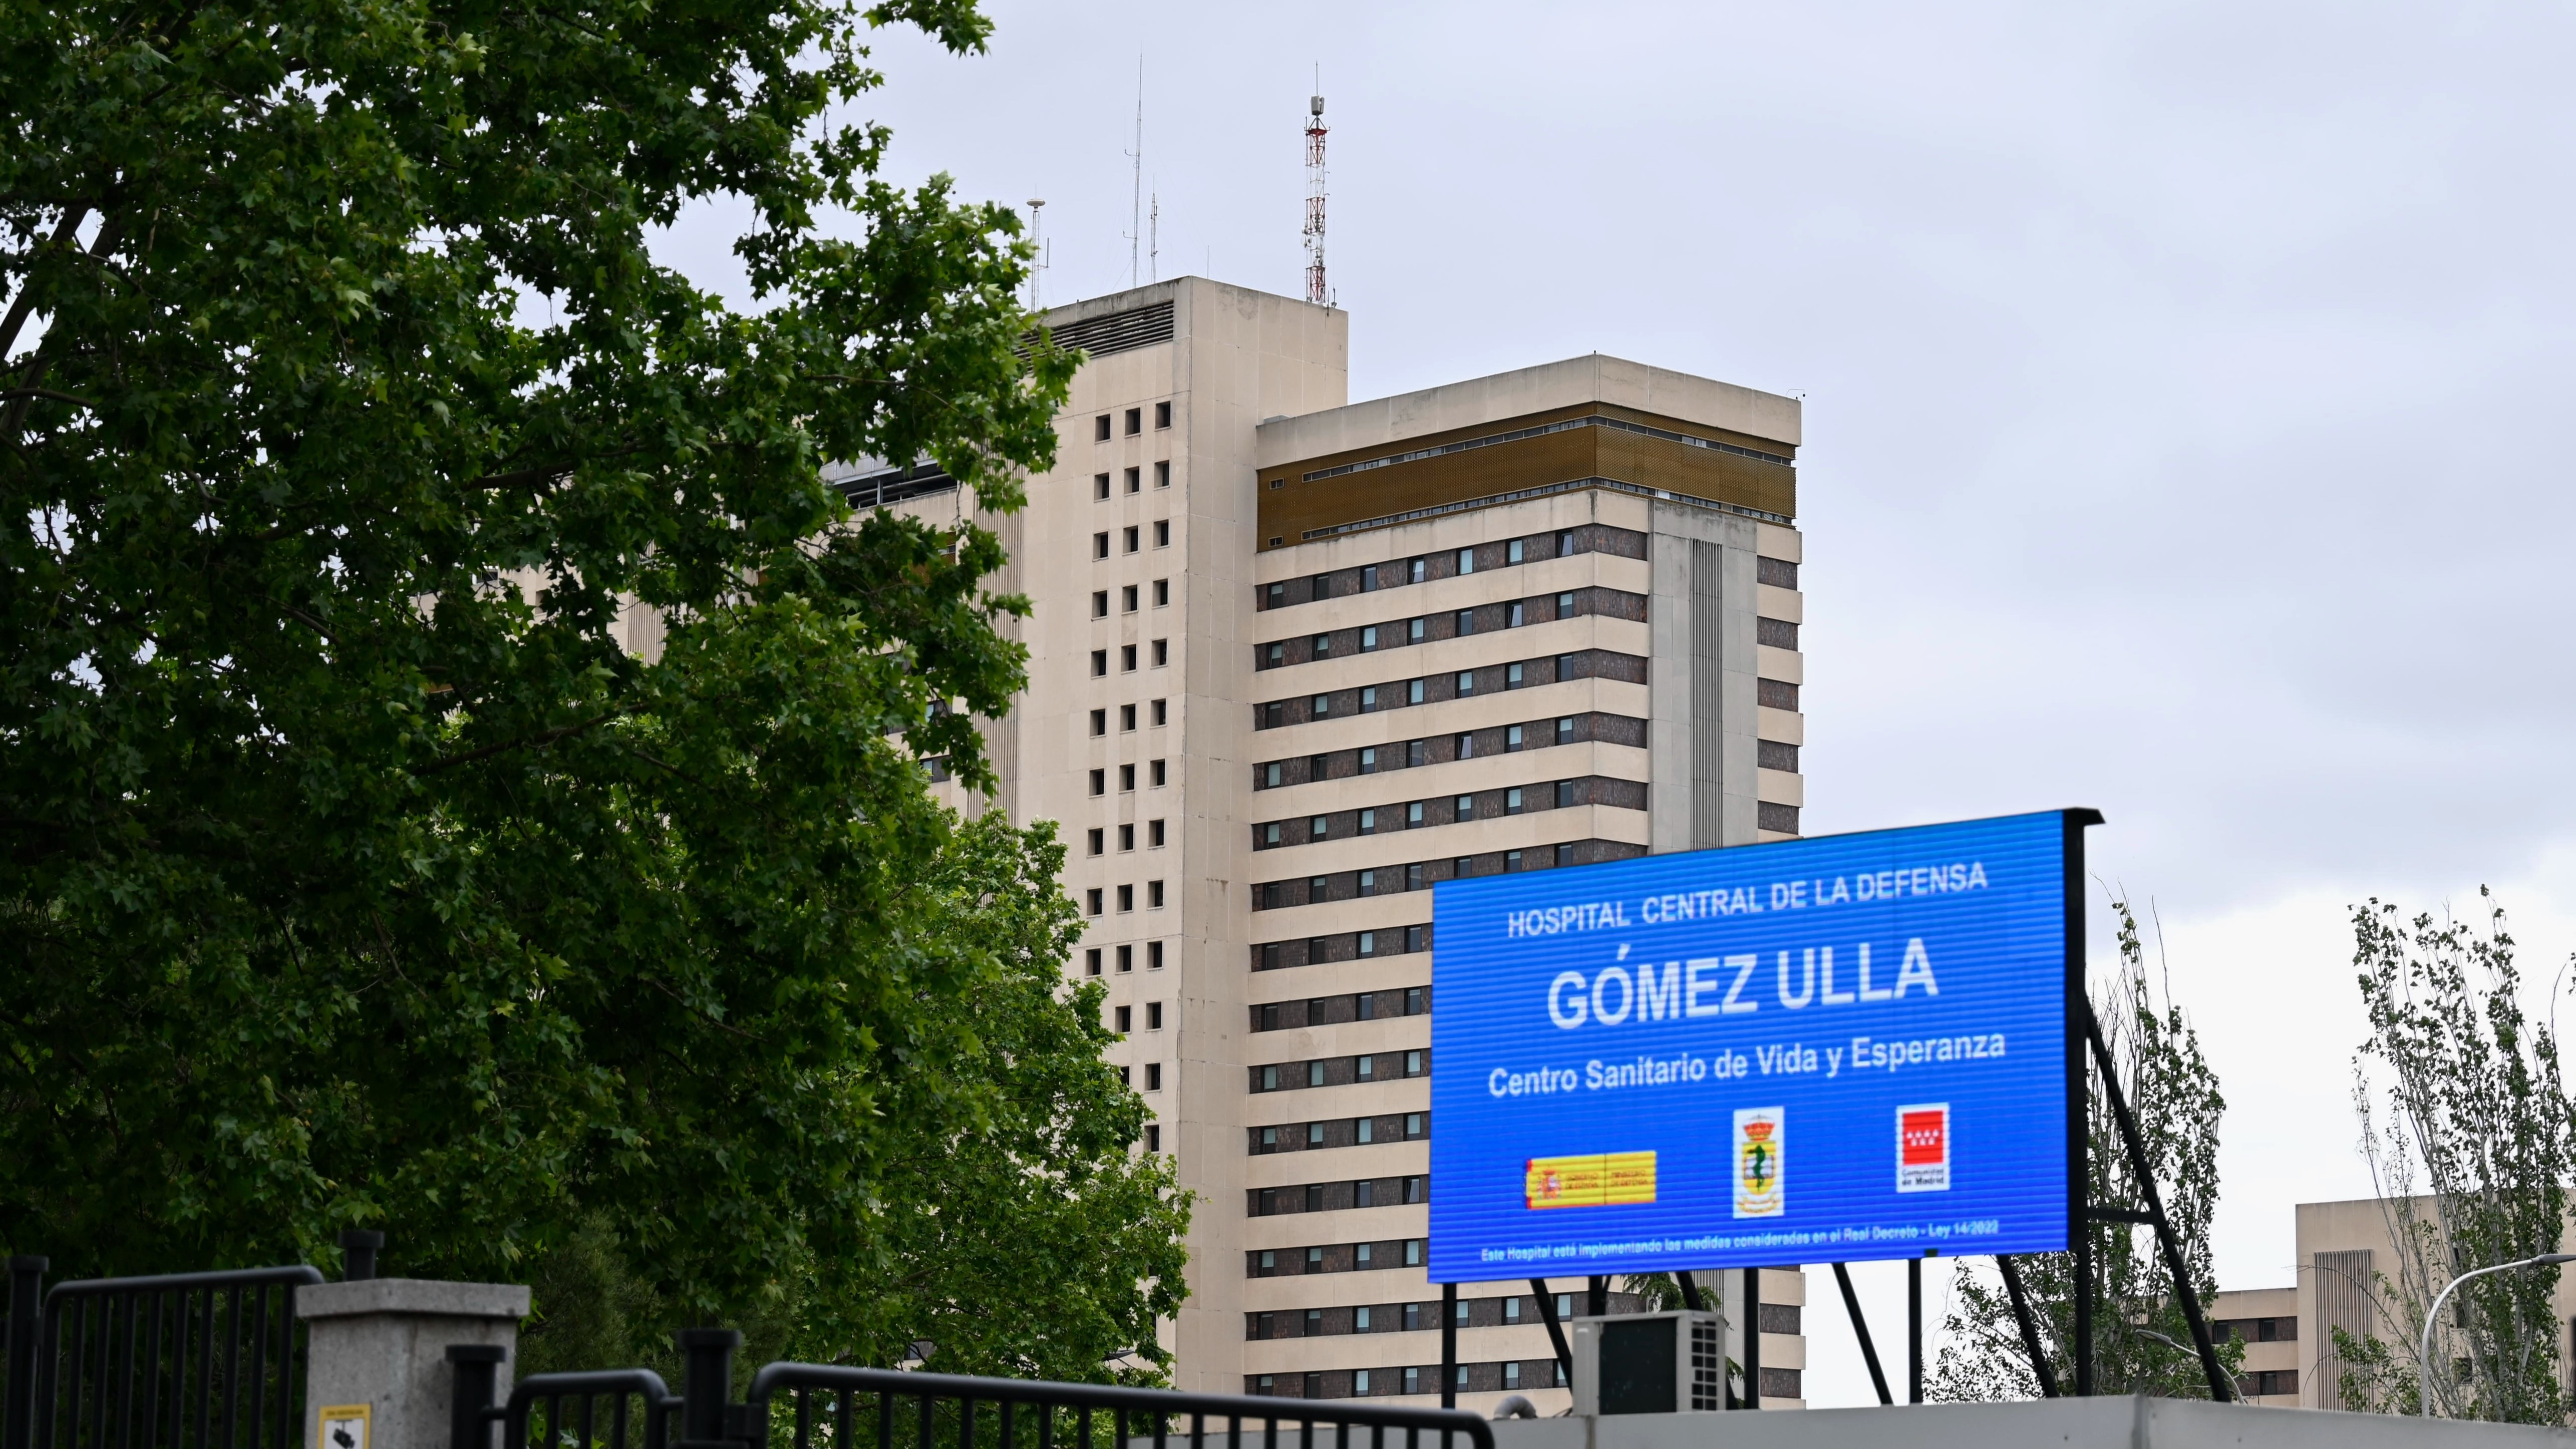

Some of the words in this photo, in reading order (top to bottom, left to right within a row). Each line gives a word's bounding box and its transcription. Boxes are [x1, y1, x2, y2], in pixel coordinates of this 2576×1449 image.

[1508, 901, 1631, 937] HOSPITAL
[1642, 886, 1764, 924] CENTRAL
[1772, 880, 1806, 910] DE
[1815, 876, 1850, 905] LA
[1857, 861, 1988, 901] DEFENSA
[1548, 943, 1758, 1029] GÓMEZ
[1777, 937, 1940, 1009] ULLA
[1489, 1066, 1577, 1097] Centro
[1585, 1052, 1706, 1090] Sanitario
[1714, 1048, 1748, 1078] de
[1756, 1043, 1817, 1074] Vida
[1826, 1047, 1843, 1078] y
[1852, 1033, 2005, 1072] Esperanza
[1481, 1248, 1504, 1261] Este
[1507, 1244, 1550, 1262] Hospital
[1553, 1242, 1576, 1258] está
[1579, 1238, 1662, 1259] implementando
[1665, 1238, 1681, 1251] las
[1684, 1235, 1731, 1250] medidas
[1734, 1231, 1809, 1248] consideradas
[1812, 1232, 1827, 1244] en
[1830, 1228, 1841, 1243] el
[1844, 1226, 1869, 1242] Real
[1872, 1225, 1918, 1240] Decreto
[1928, 1223, 1951, 1239] Ley
[1953, 1219, 1999, 1235] 14/2022
